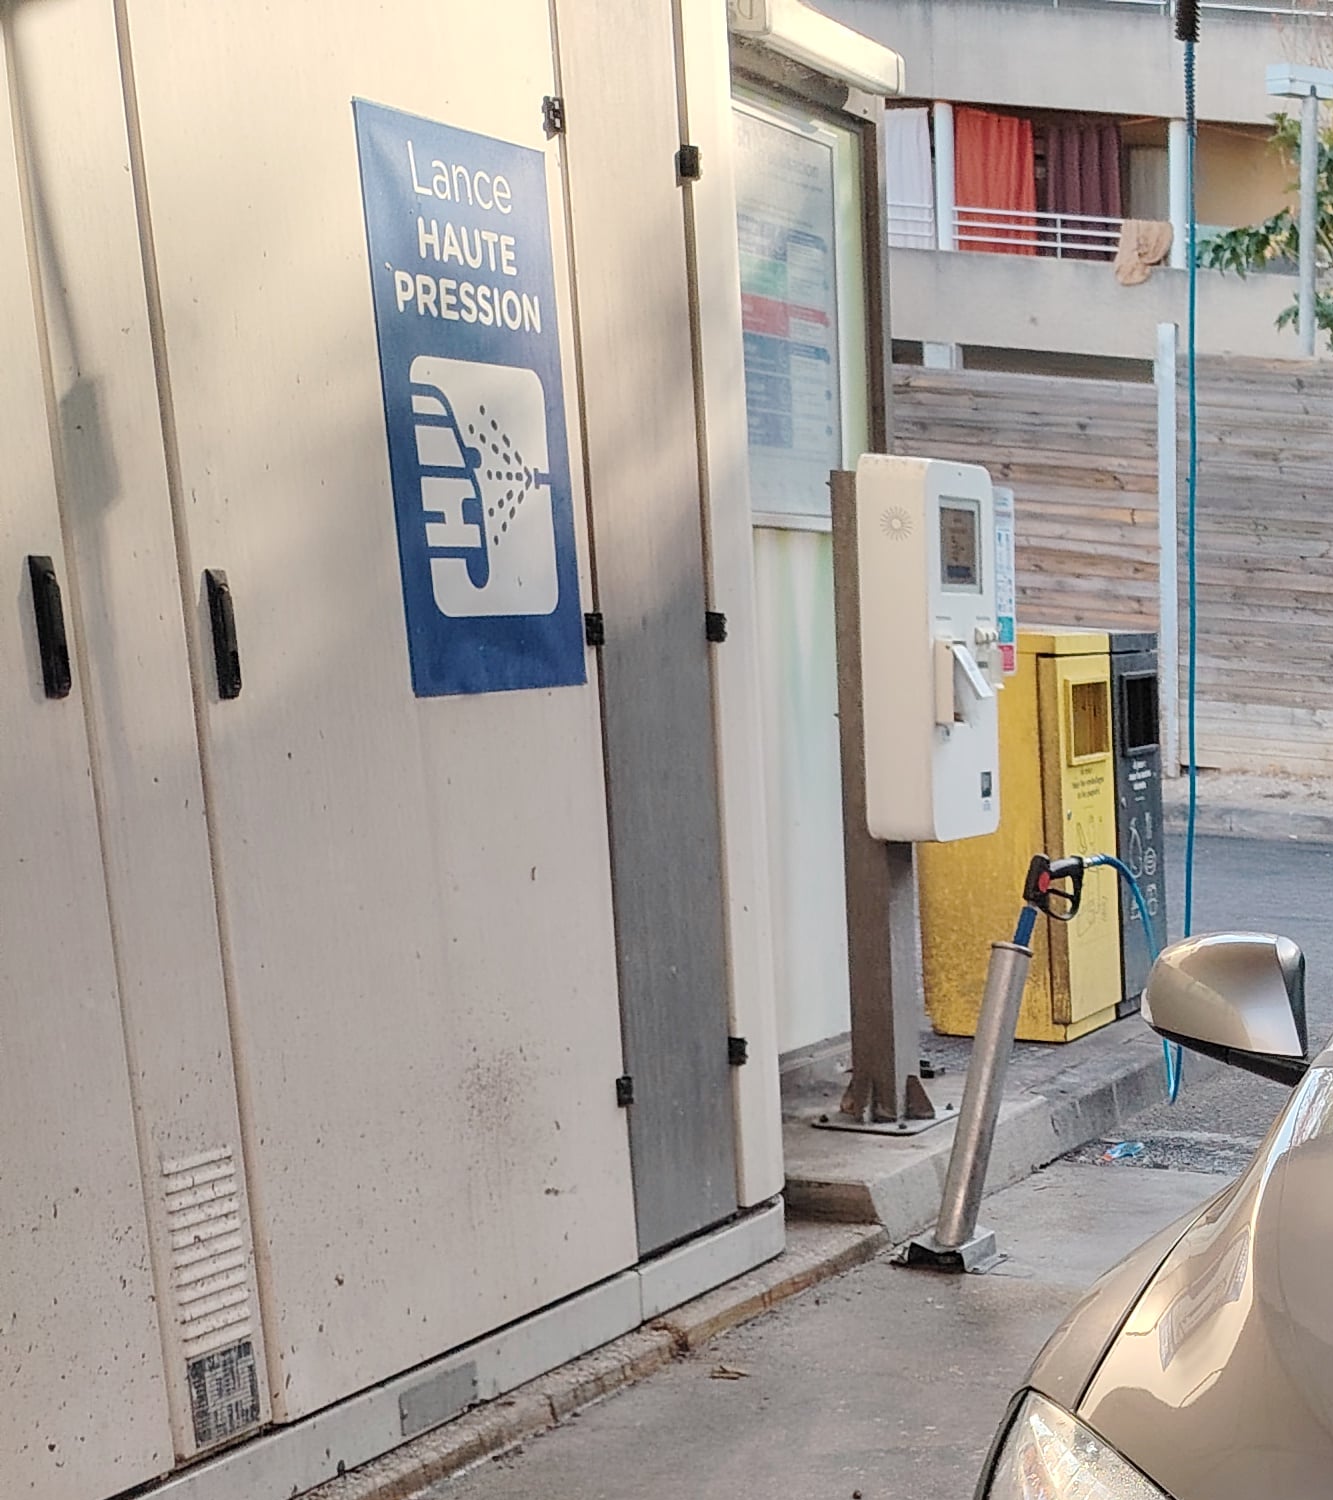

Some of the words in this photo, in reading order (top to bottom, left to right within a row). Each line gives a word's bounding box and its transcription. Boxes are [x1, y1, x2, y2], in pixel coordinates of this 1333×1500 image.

[406, 140, 512, 214] Lance
[417, 216, 518, 276] HAUTE
[394, 271, 542, 335] PRESSION
